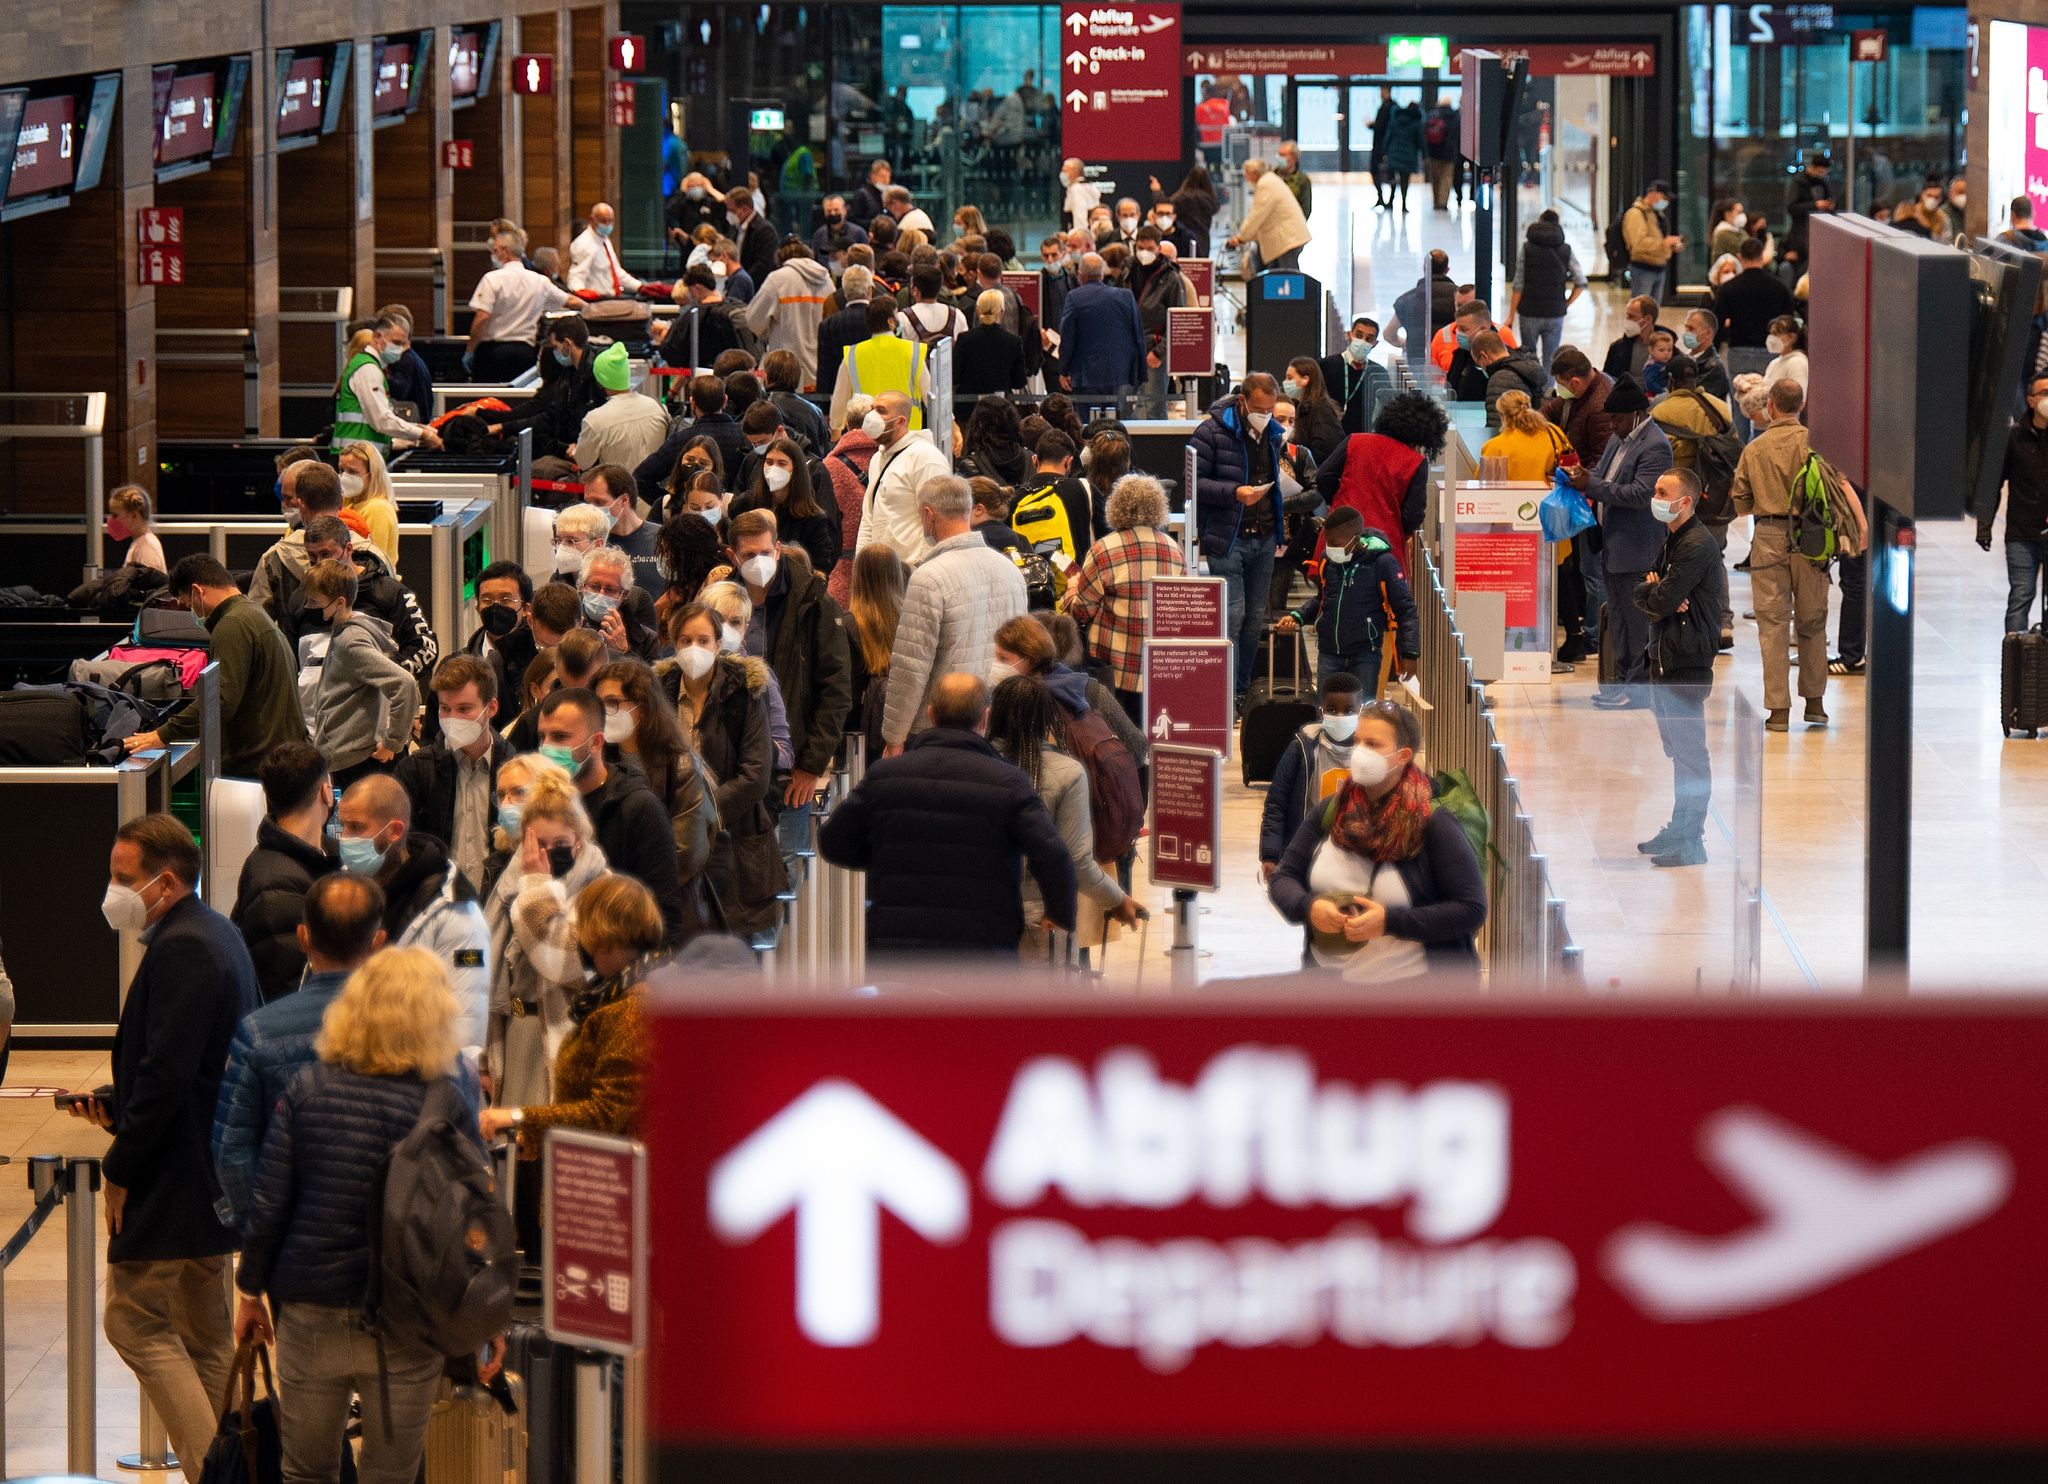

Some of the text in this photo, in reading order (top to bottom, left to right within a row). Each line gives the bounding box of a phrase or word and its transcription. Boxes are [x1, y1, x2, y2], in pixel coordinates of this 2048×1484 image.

[1089, 9, 1133, 25] Abflug
[1090, 24, 1140, 38] Departure
[1090, 46, 1145, 60] Check-in
[1594, 48, 1630, 62] Abflug
[1457, 503, 1475, 514] ER
[988, 1046, 1509, 1242] Abflug
[991, 1221, 1573, 1366] Departure
